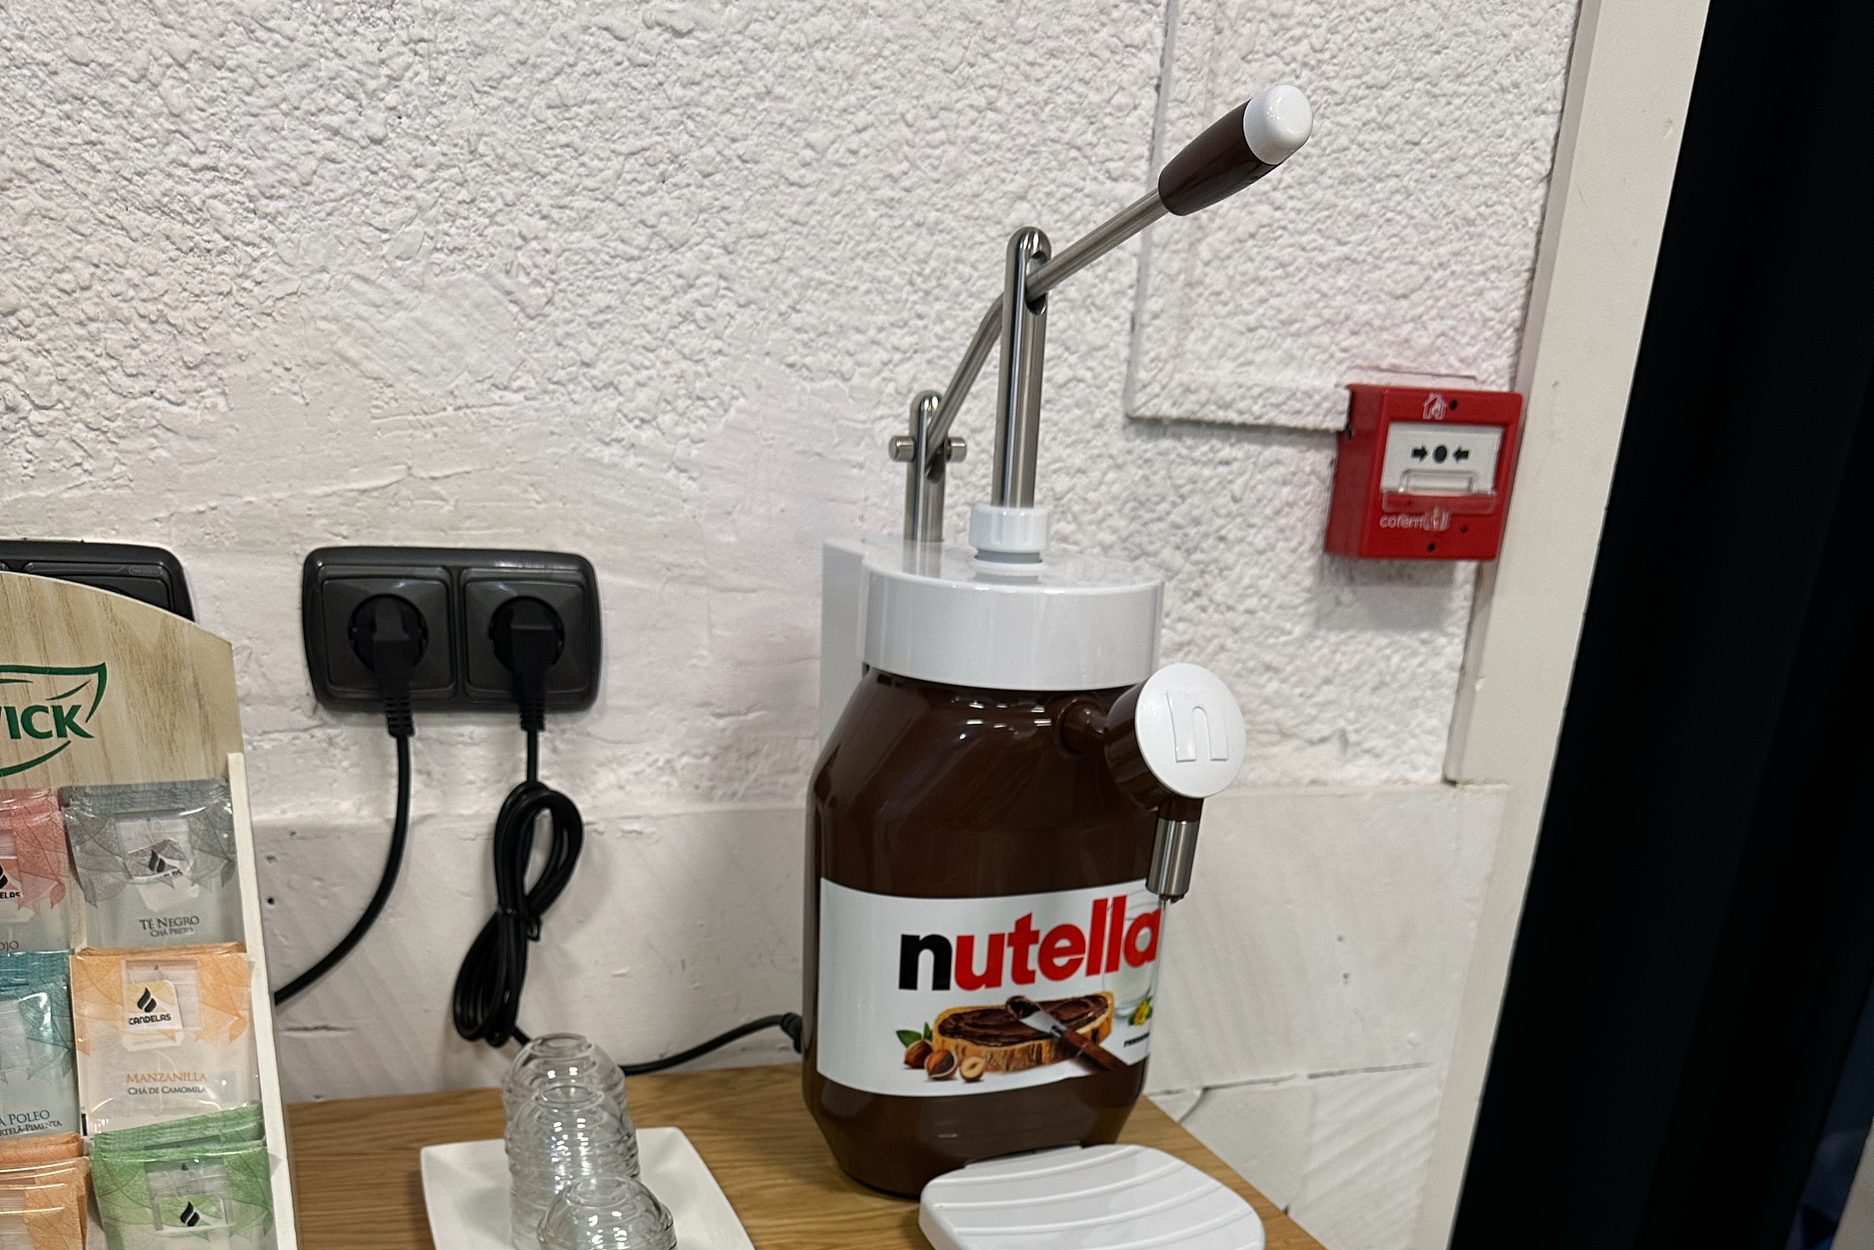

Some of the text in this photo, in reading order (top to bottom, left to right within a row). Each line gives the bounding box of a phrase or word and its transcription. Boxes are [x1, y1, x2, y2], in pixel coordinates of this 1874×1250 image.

[0, 704, 95, 740] ICK
[139, 915, 200, 930] TÉ NEGRO
[898, 895, 1162, 993] nutella
[128, 1013, 172, 1025] CANDELAS
[126, 1071, 208, 1084] MANZANILLA
[128, 1085, 207, 1096] CHÁ DE CAMOMILA
[8, 1109, 51, 1126] POLEO
